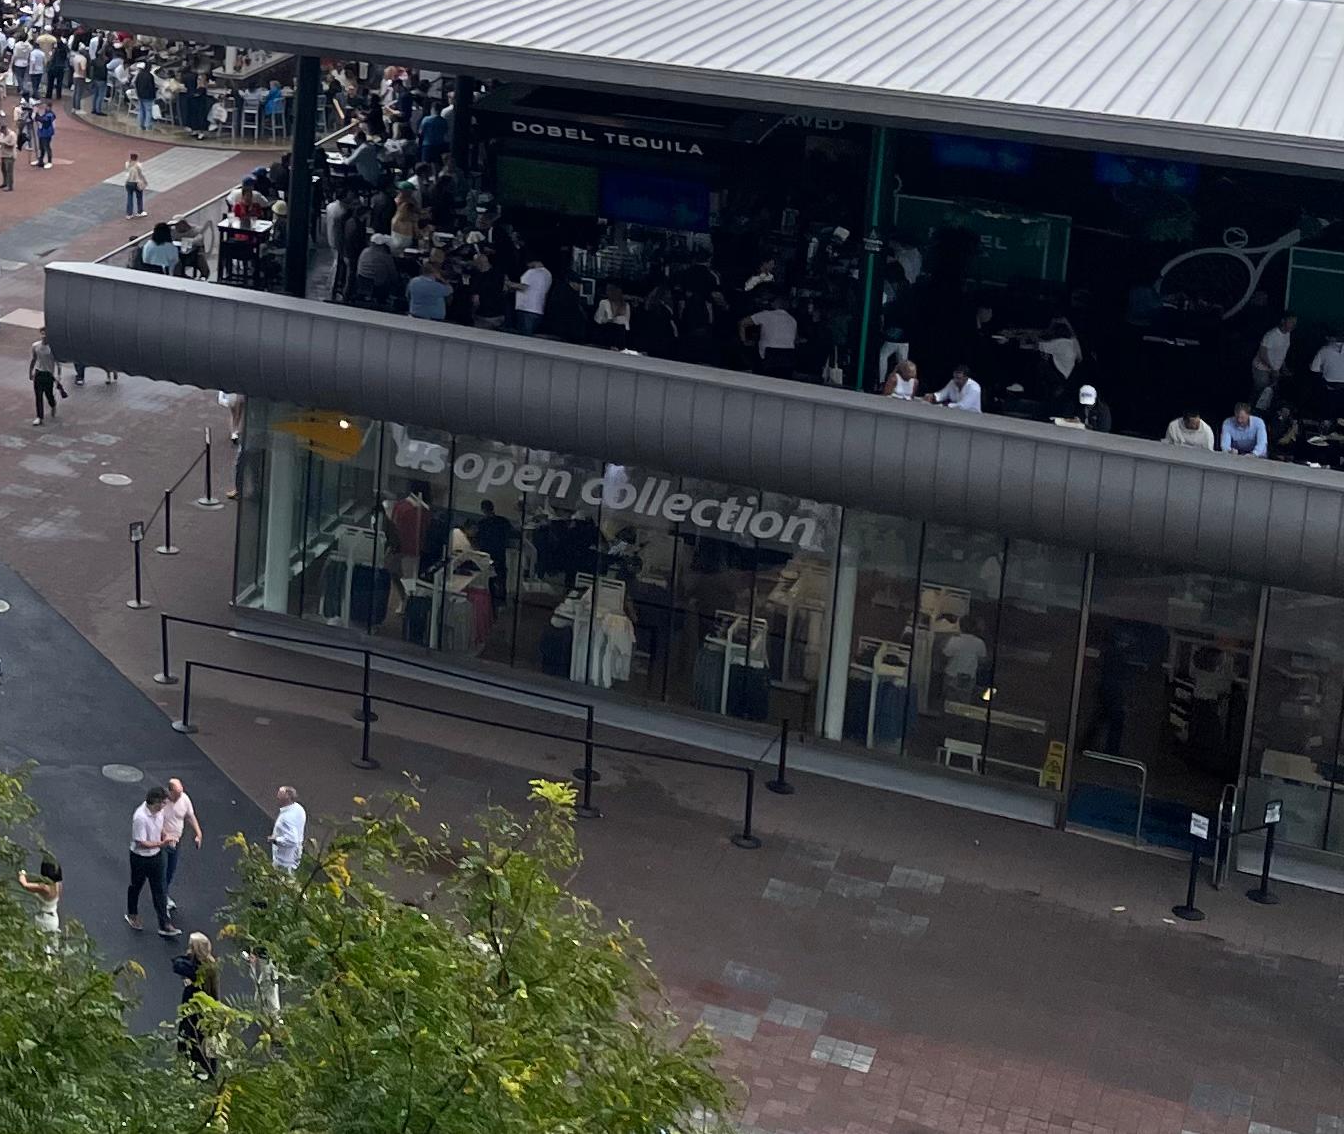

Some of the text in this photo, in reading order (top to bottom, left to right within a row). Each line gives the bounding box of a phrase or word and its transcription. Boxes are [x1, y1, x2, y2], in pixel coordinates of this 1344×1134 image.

[512, 121, 704, 156] DOBEL TEQUILA
[393, 439, 824, 551] us open collection
